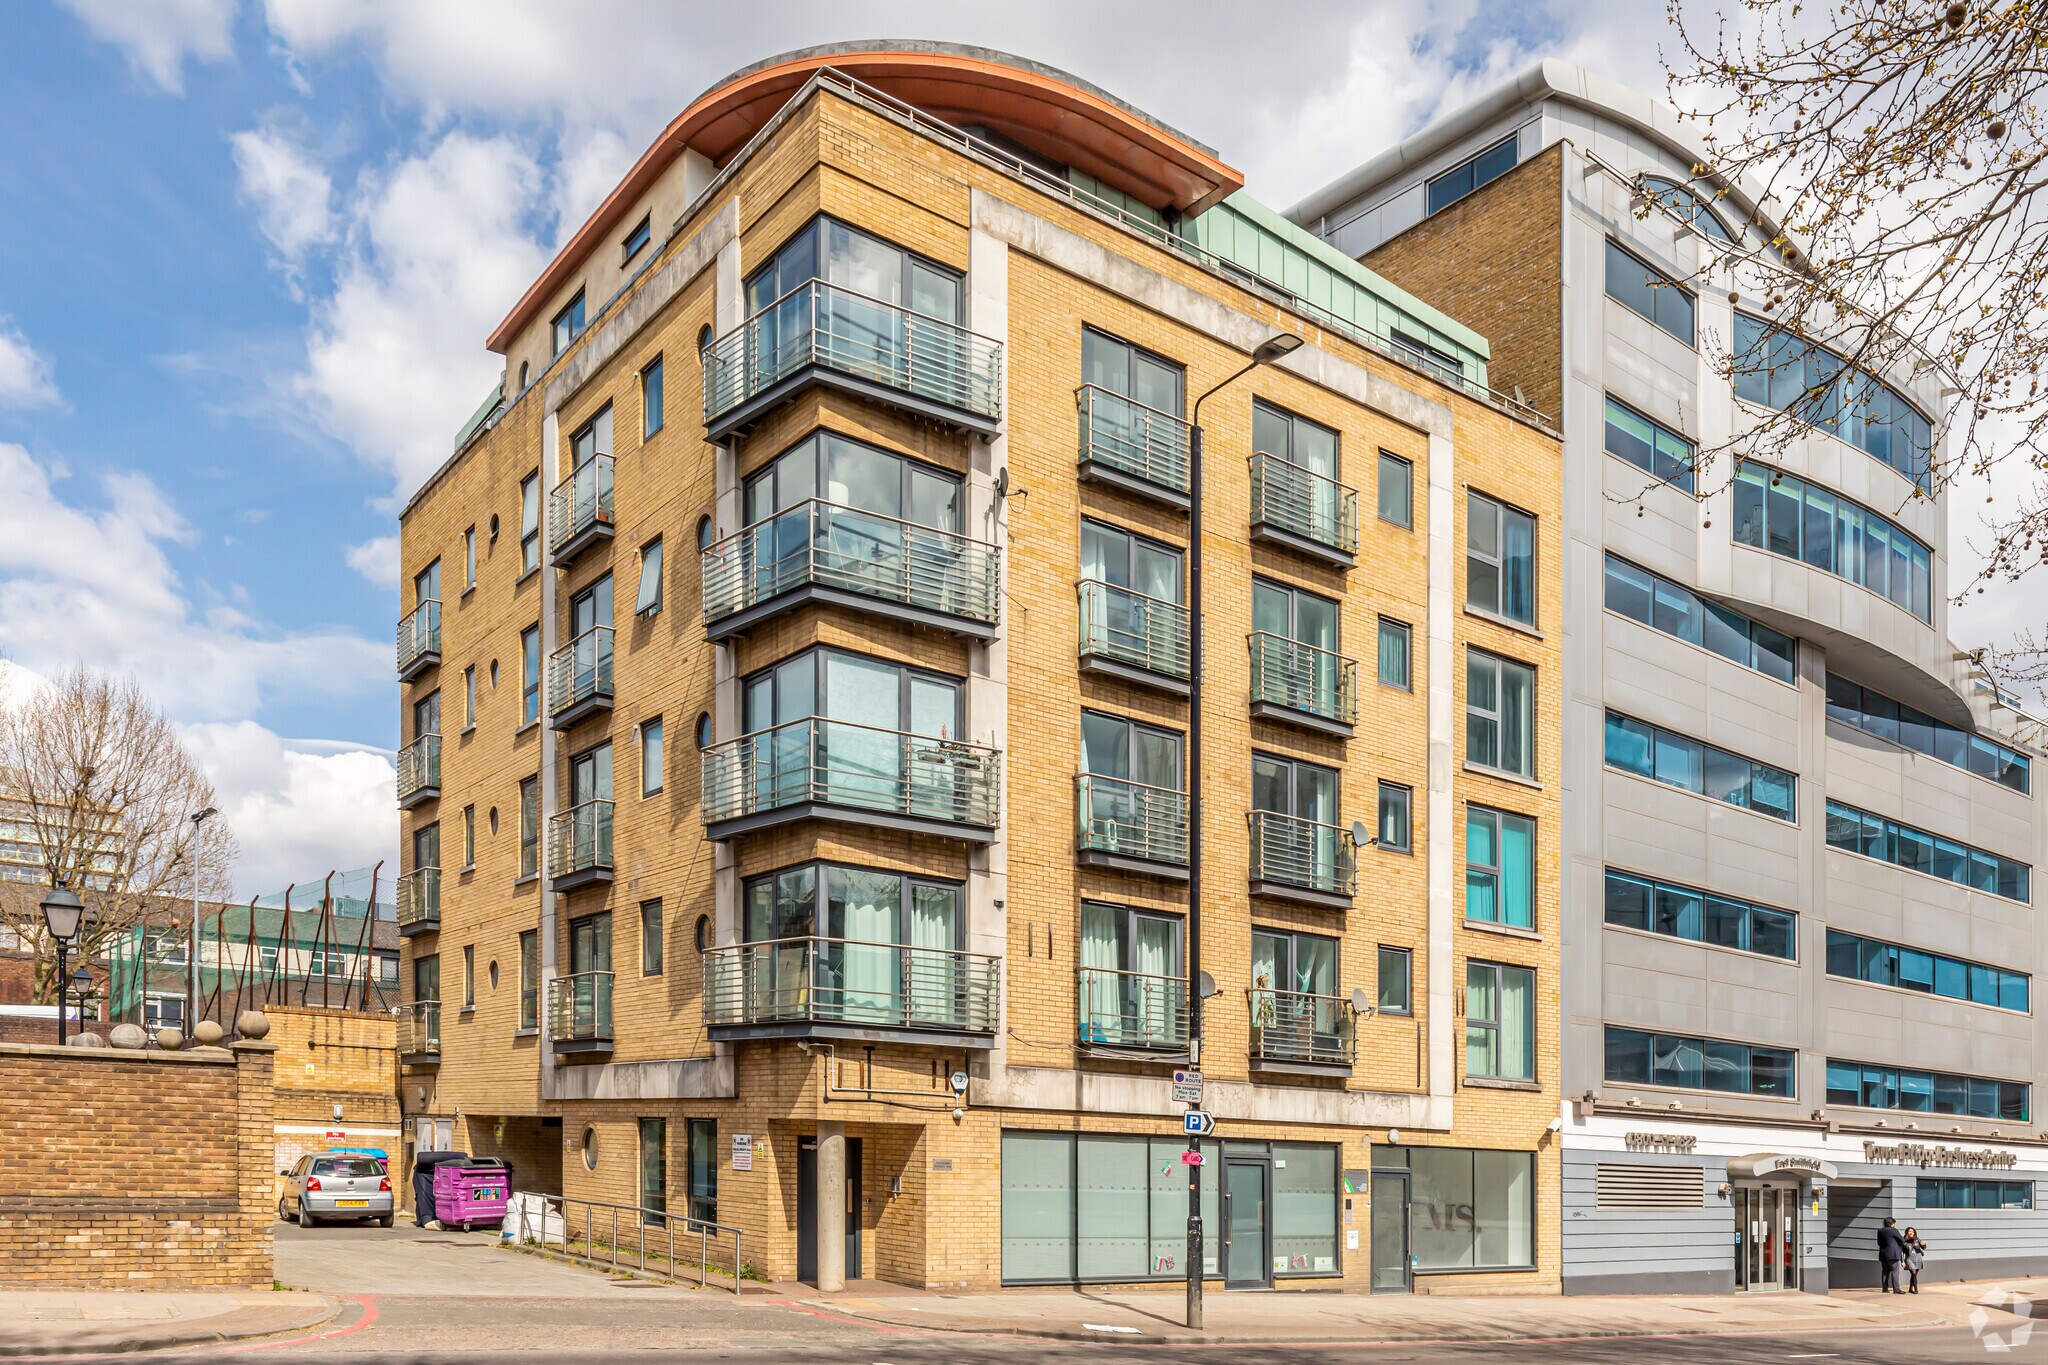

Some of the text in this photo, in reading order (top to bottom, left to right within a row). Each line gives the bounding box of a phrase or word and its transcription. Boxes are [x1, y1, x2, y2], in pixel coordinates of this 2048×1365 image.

[1190, 1116, 1199, 1128] P
[1863, 1141, 2017, 1165] Tower Bridge Business Centre
